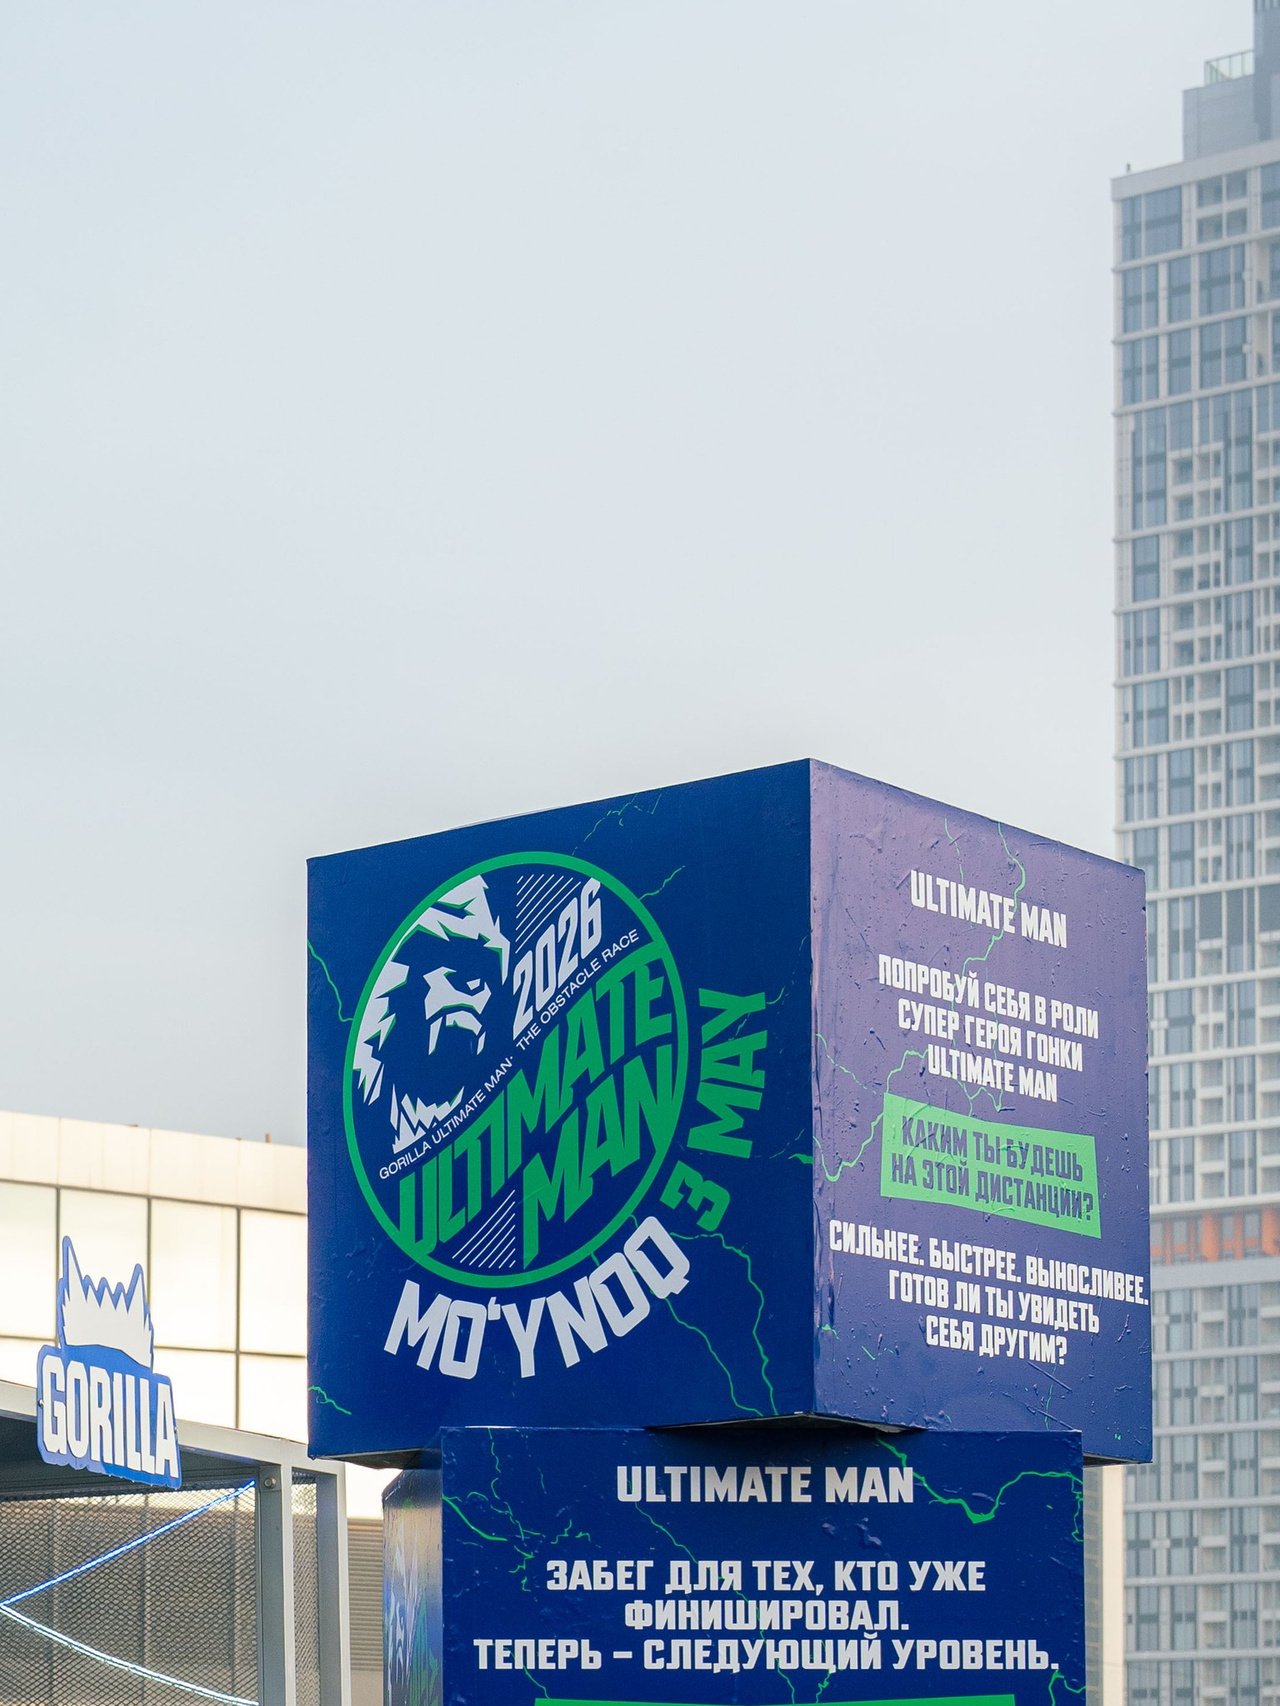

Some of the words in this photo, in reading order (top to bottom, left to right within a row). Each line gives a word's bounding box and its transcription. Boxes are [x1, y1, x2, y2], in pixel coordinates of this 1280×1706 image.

[911, 870, 1016, 934] ULTIMATE
[1021, 902, 1067, 948] MAN
[513, 877, 602, 1041] 2026
[879, 954, 979, 1008] ПОПРОБУЙ
[985, 982, 1030, 1021] СЕБЯ
[1035, 995, 1046, 1026] В
[1051, 1000, 1098, 1039] РОЛИ
[379, 1141, 432, 1179] GORILLA
[431, 1089, 486, 1144] ULTIMATE
[516, 1023, 541, 1050] THE
[540, 958, 602, 1024] OBSTACLE
[602, 929, 639, 962] RACE
[898, 998, 959, 1040] СУПЕР
[965, 1014, 1021, 1056] ГЕРОЯ
[1027, 1030, 1083, 1071] ГОНКИ
[399, 945, 672, 1255] ULTIMATE
[687, 987, 768, 1159] MAY
[928, 1044, 1014, 1092] ULTIMATE
[1019, 1066, 1057, 1102] MAN
[523, 1045, 672, 1270] MAN
[902, 1115, 968, 1158] КАКИМ
[973, 1131, 1000, 1164] ТЫ
[1006, 1138, 1084, 1182] БУДЕШЬ
[660, 1160, 730, 1232] 3
[892, 1153, 917, 1186] НА
[922, 1158, 969, 1197] ЭТОЙ
[975, 1171, 1093, 1220] ДИСТАНЦИИ?
[830, 1220, 924, 1266] СИЛЬНЕЕ.
[929, 1238, 1021, 1283] БЫСТРЕЕ.
[1026, 1255, 1149, 1306] ВЫНОСЛИВЕЕ.
[889, 1270, 949, 1308] ГОТОВ
[954, 1281, 980, 1314] ЛИ
[985, 1287, 1014, 1320] ТЫ
[1019, 1292, 1099, 1333] УВИДЕТЬ
[926, 1315, 974, 1352] СЕБЯ
[979, 1324, 1067, 1365] ДРУГИМ?
[42, 1355, 179, 1478] GORILLA
[617, 1466, 812, 1503] ULTIMATE
[825, 1467, 914, 1503] MAN
[546, 1561, 654, 1591] ЗАБЕГ
[665, 1561, 742, 1594] ДЛЯ
[752, 1561, 824, 1596] ТЕХ,
[834, 1561, 899, 1591] КТО
[908, 1561, 986, 1591] УЖЕ
[624, 1600, 910, 1631] ФИНИШИРОВАЛ.
[473, 1640, 602, 1670] ТЕПЕРЬ
[643, 1633, 881, 1674] СЛЕДУЮЩИЙ
[892, 1640, 1060, 1671] УРОВЕНЬ.
